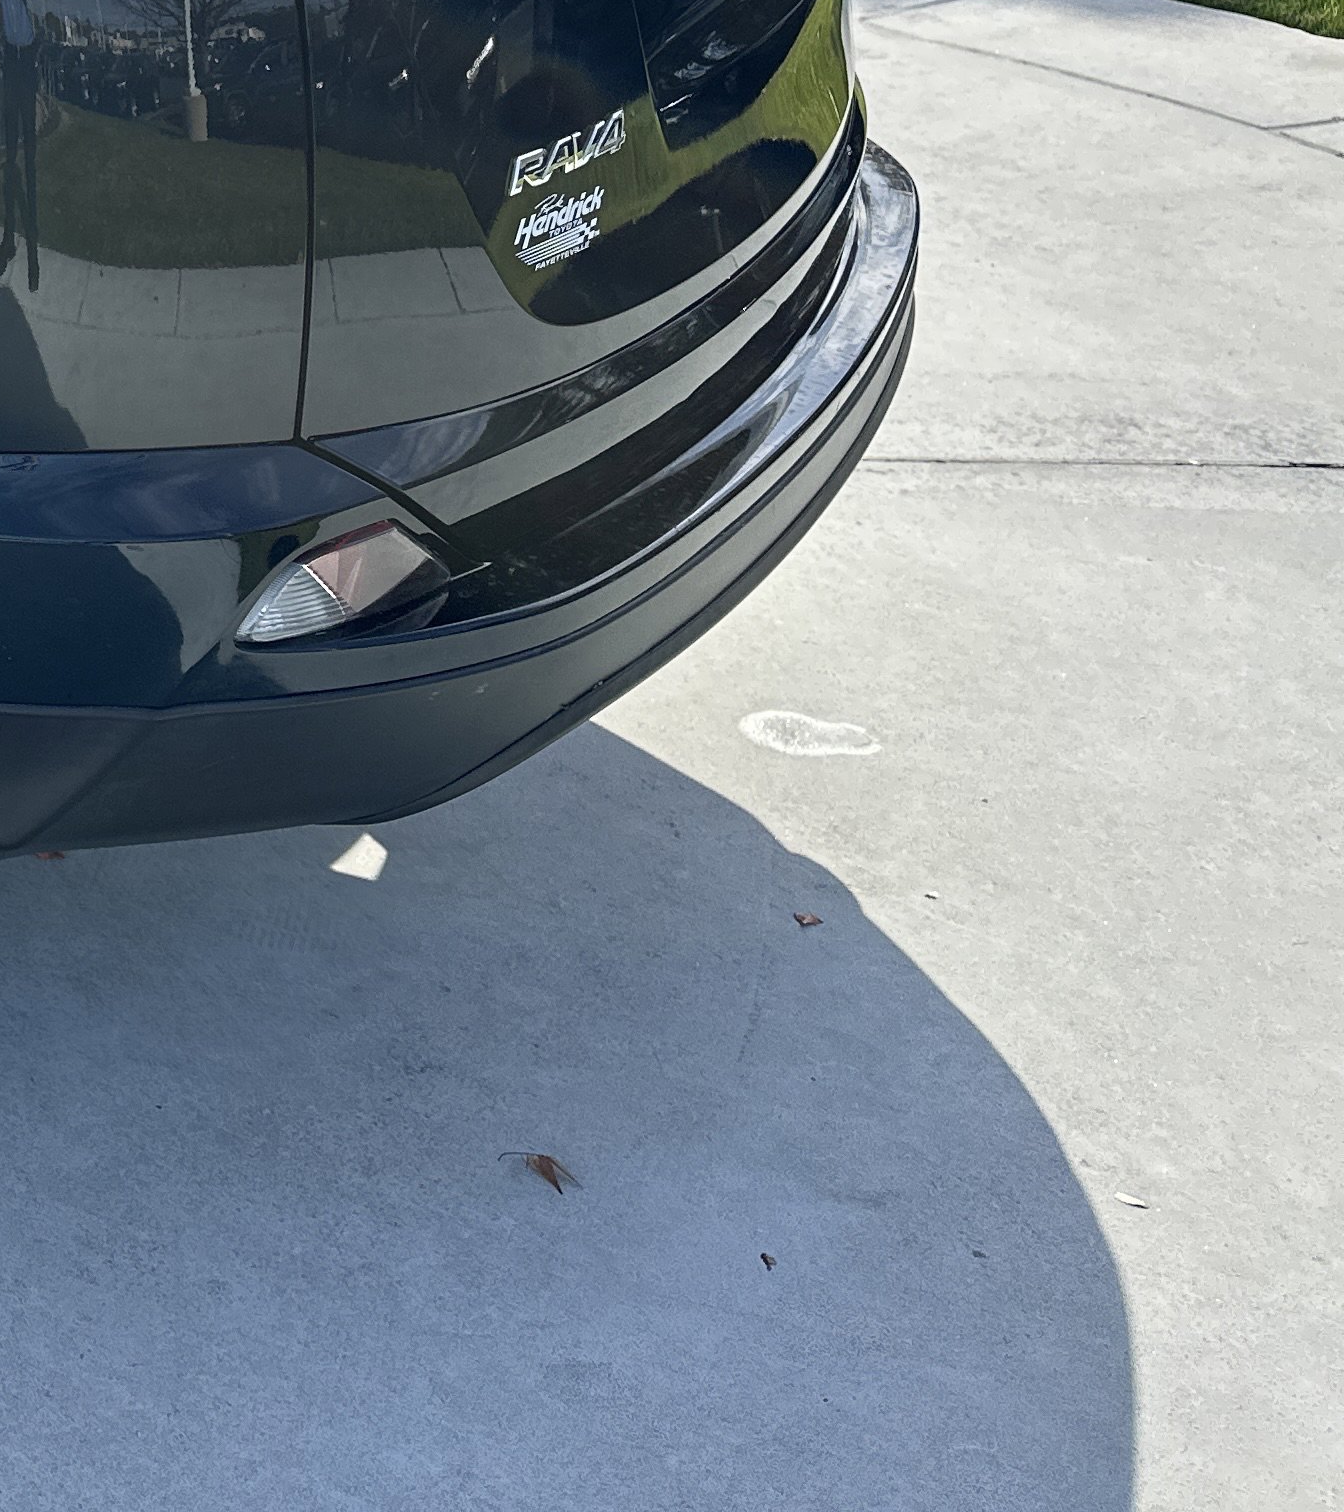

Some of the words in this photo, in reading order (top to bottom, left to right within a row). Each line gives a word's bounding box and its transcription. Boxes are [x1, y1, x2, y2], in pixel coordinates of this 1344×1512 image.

[508, 107, 627, 197] RAV4
[514, 185, 605, 250] Hendrick
[548, 218, 584, 238] TOYOTA
[534, 240, 590, 272] FAYETTEVILLE
